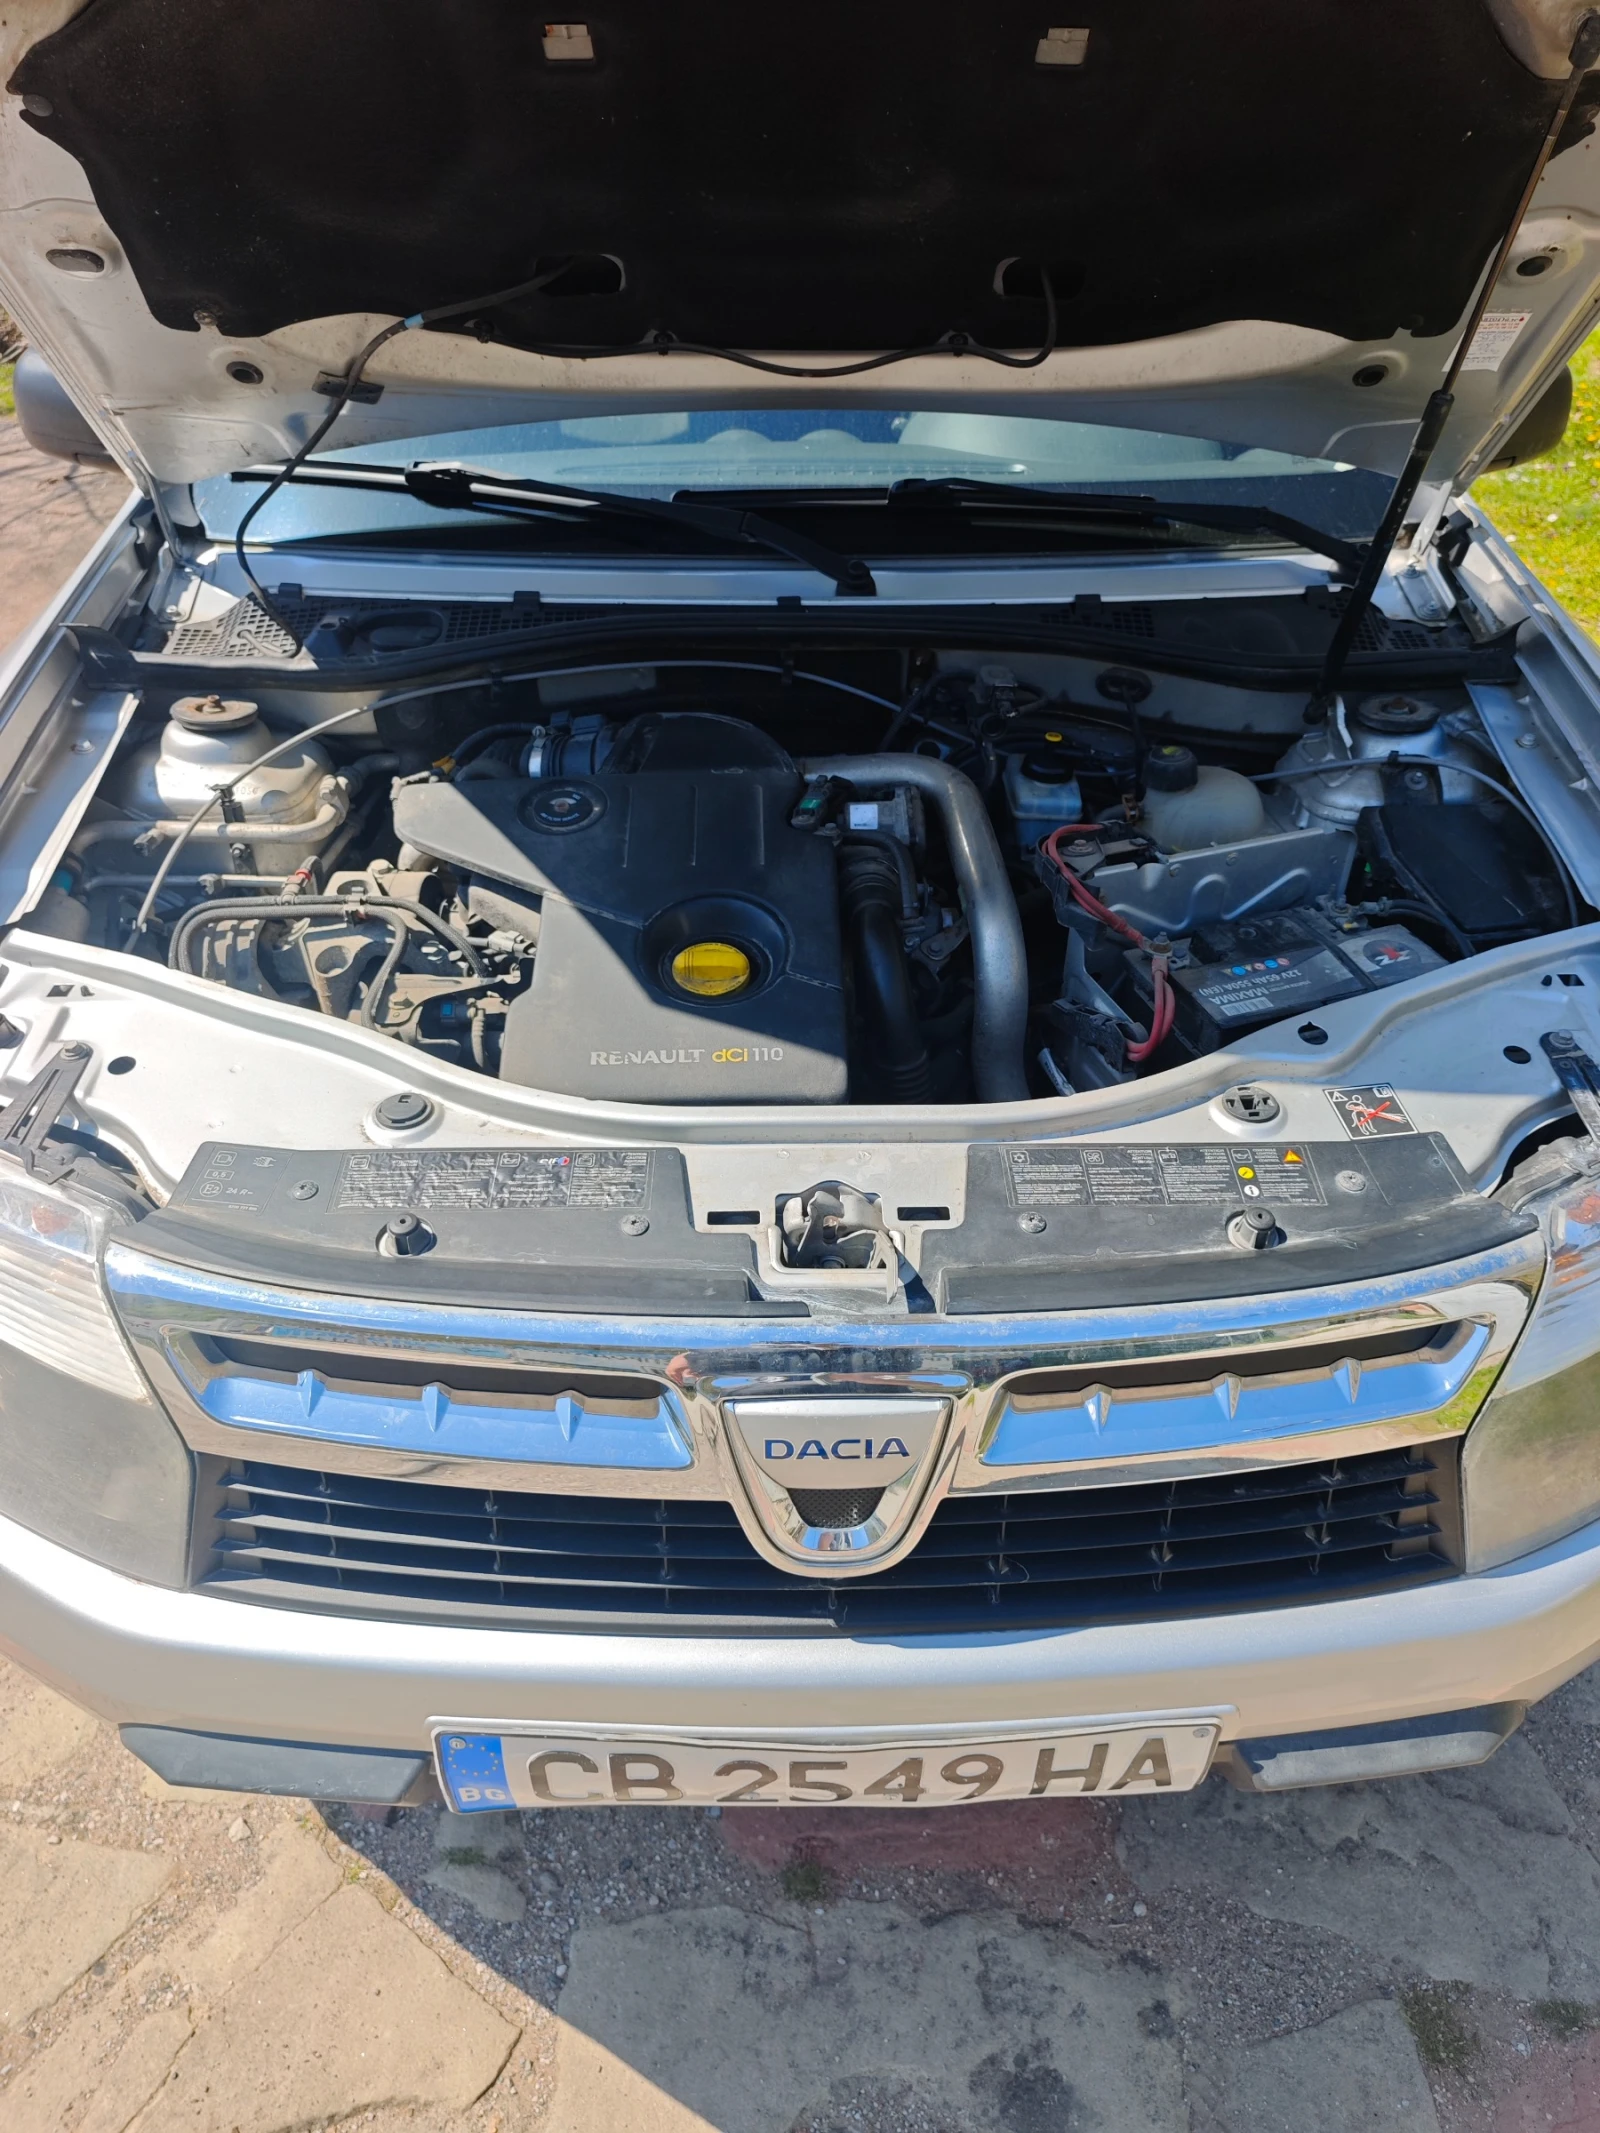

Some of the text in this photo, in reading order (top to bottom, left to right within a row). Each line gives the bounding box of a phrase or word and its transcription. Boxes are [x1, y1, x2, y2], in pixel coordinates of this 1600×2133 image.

[1198, 969, 1302, 996] 12V 65Ah 550A (EN)
[1208, 986, 1270, 1005] MAXIMA
[590, 1047, 784, 1065] RENAULT dCi 110
[202, 1183, 219, 1194] E2
[764, 1437, 910, 1460] DACIA
[526, 1737, 1172, 1803] CB 2549 HA
[457, 1786, 506, 1803] BG
